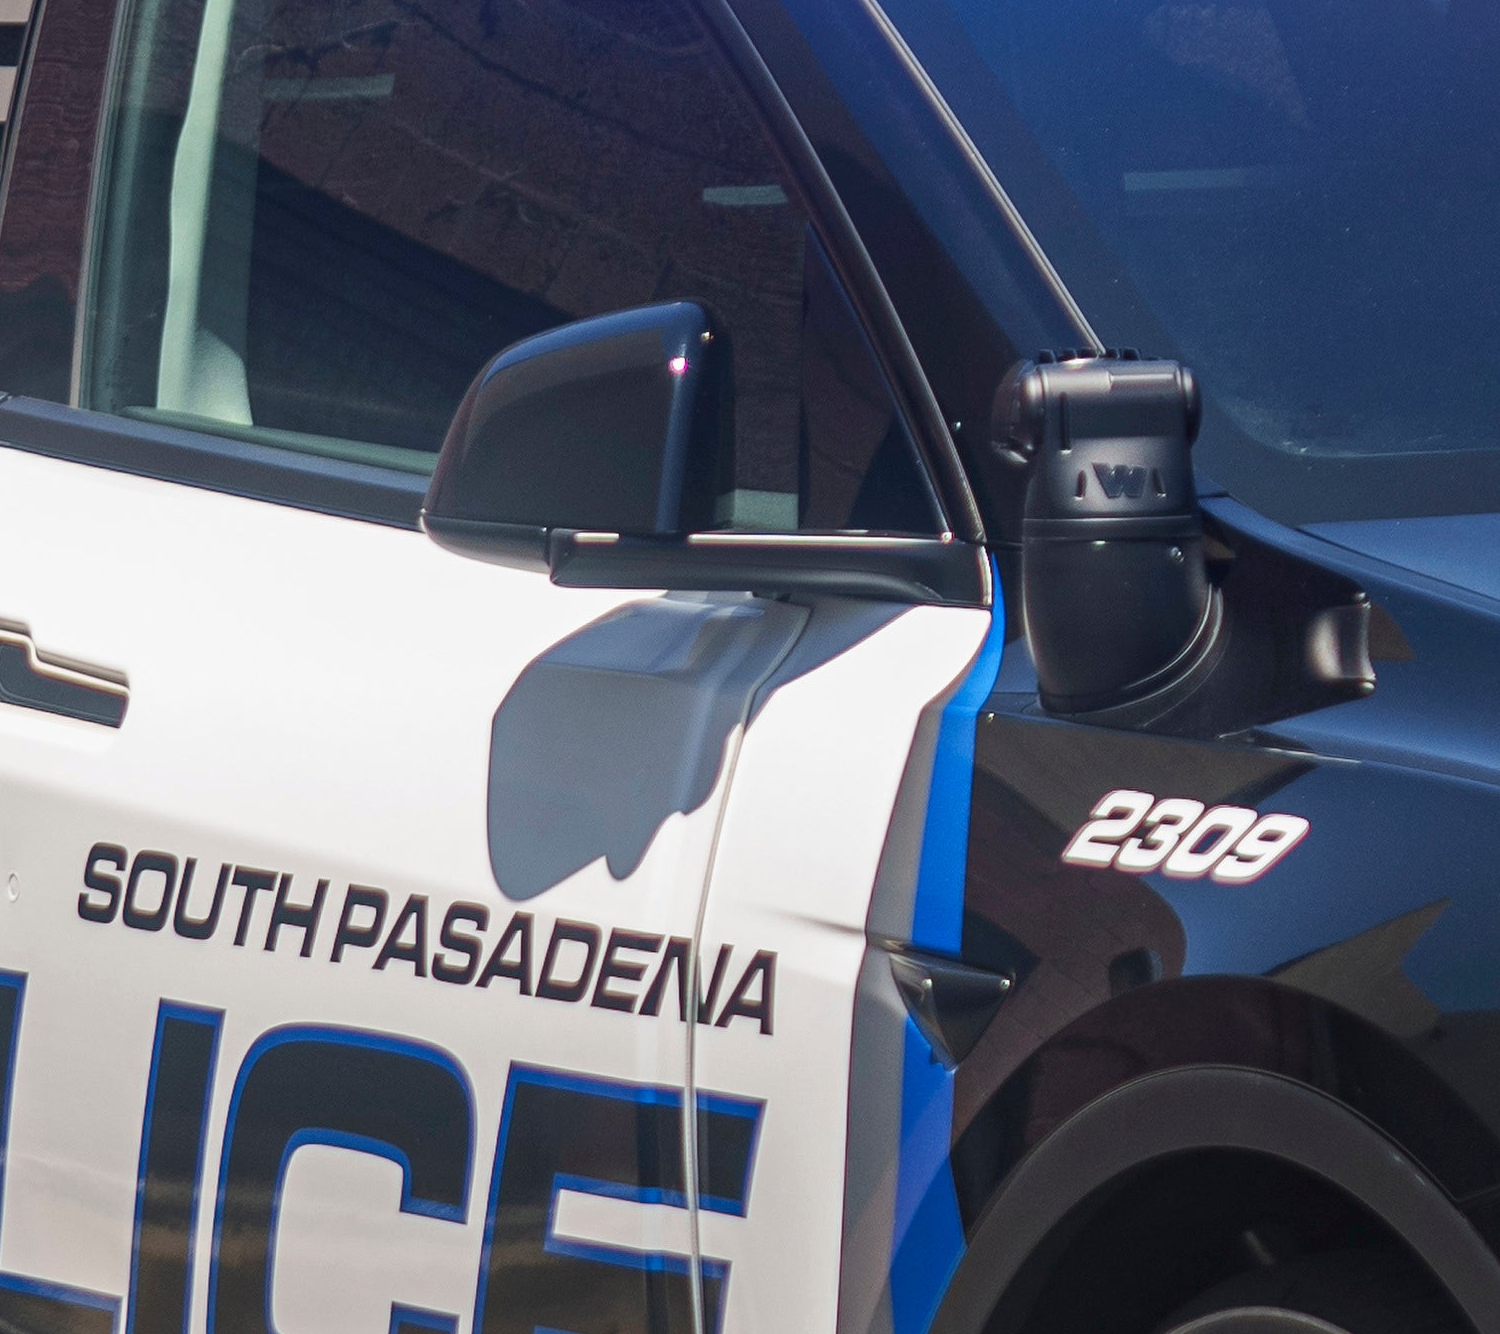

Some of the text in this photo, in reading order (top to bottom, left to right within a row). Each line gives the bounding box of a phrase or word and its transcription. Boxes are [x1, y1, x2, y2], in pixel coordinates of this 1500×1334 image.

[1061, 787, 1312, 885] 2309
[77, 841, 775, 1038] SOUTH PASADENA
